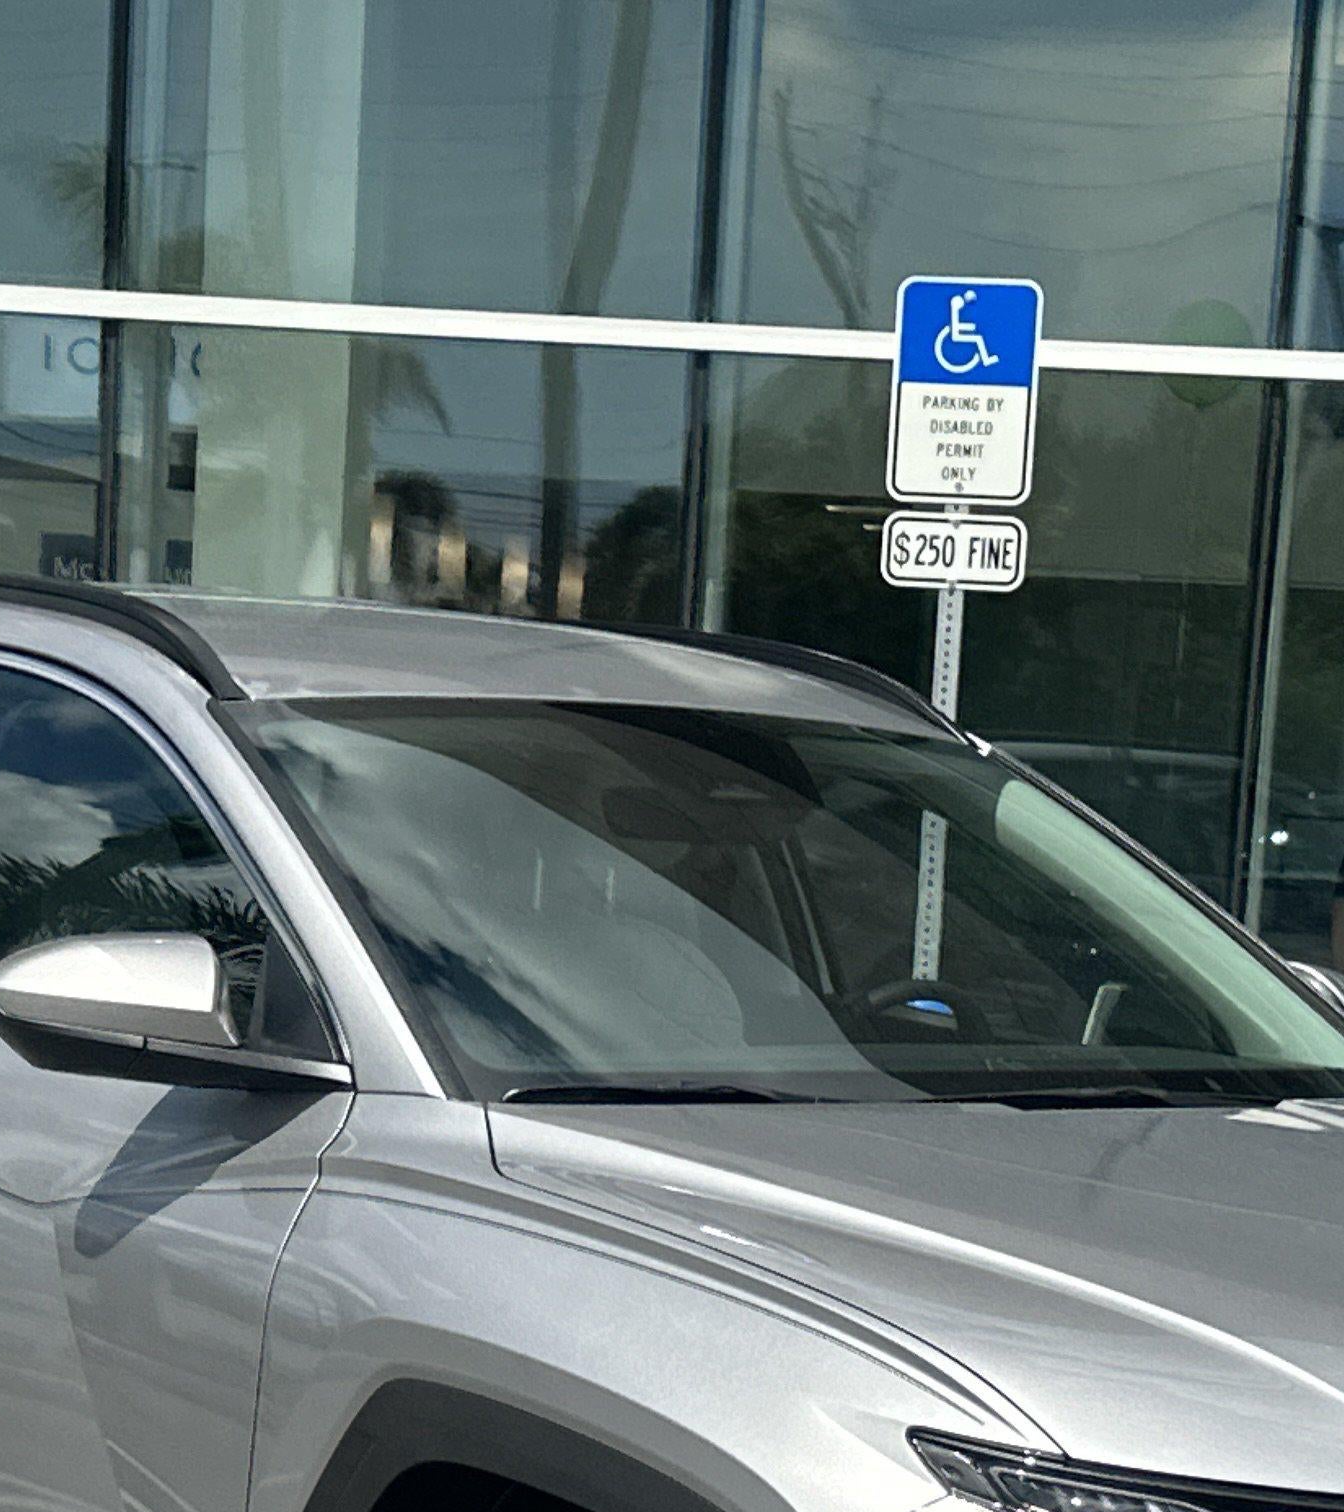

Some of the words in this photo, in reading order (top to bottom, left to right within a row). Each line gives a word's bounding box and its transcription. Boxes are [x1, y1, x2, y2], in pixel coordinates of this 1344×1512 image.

[922, 395, 980, 411] PARKING
[986, 397, 1004, 412] BY
[930, 418, 994, 435] DISABLED
[936, 442, 984, 458] PERMIT
[941, 465, 976, 481] ONLY
[893, 530, 955, 569] $250
[967, 536, 1014, 571] FINE
